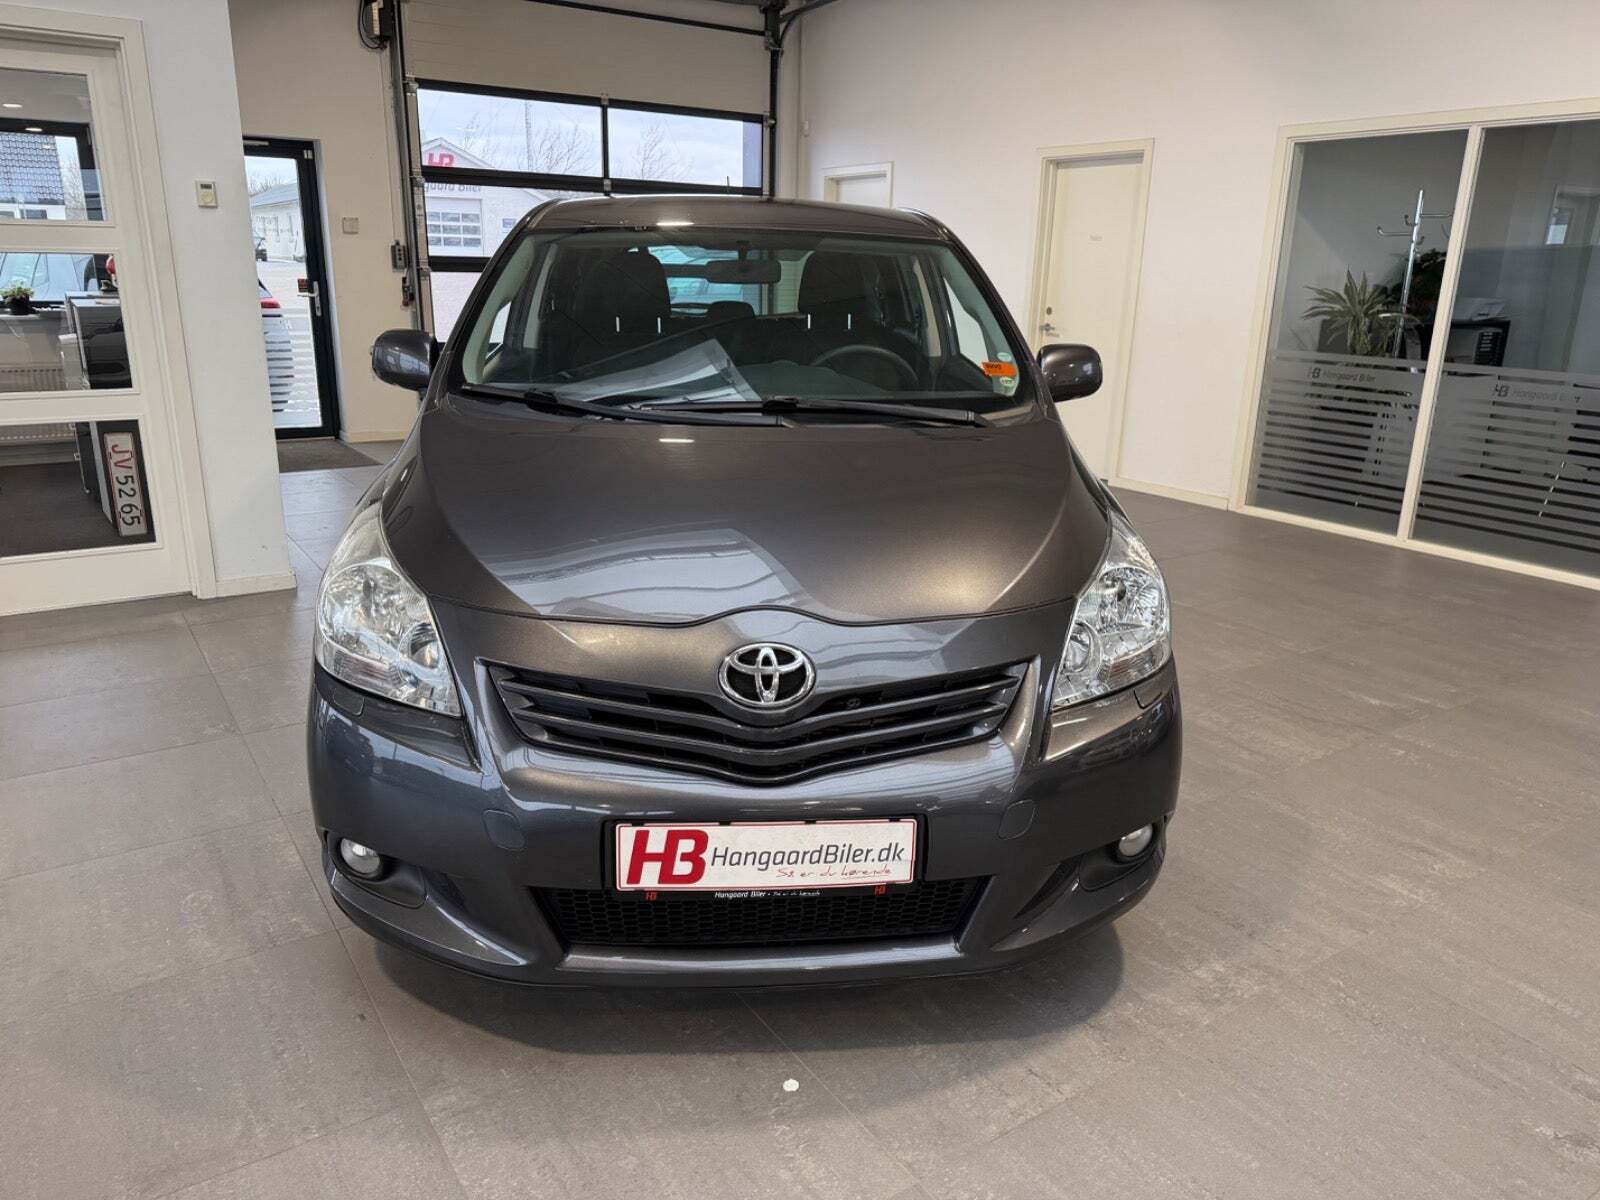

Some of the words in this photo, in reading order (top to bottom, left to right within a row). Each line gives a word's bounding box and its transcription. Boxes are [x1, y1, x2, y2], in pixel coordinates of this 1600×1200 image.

[111, 444, 133, 470] JV
[626, 829, 709, 885] HB
[711, 842, 905, 871] HangaardBiler.dk
